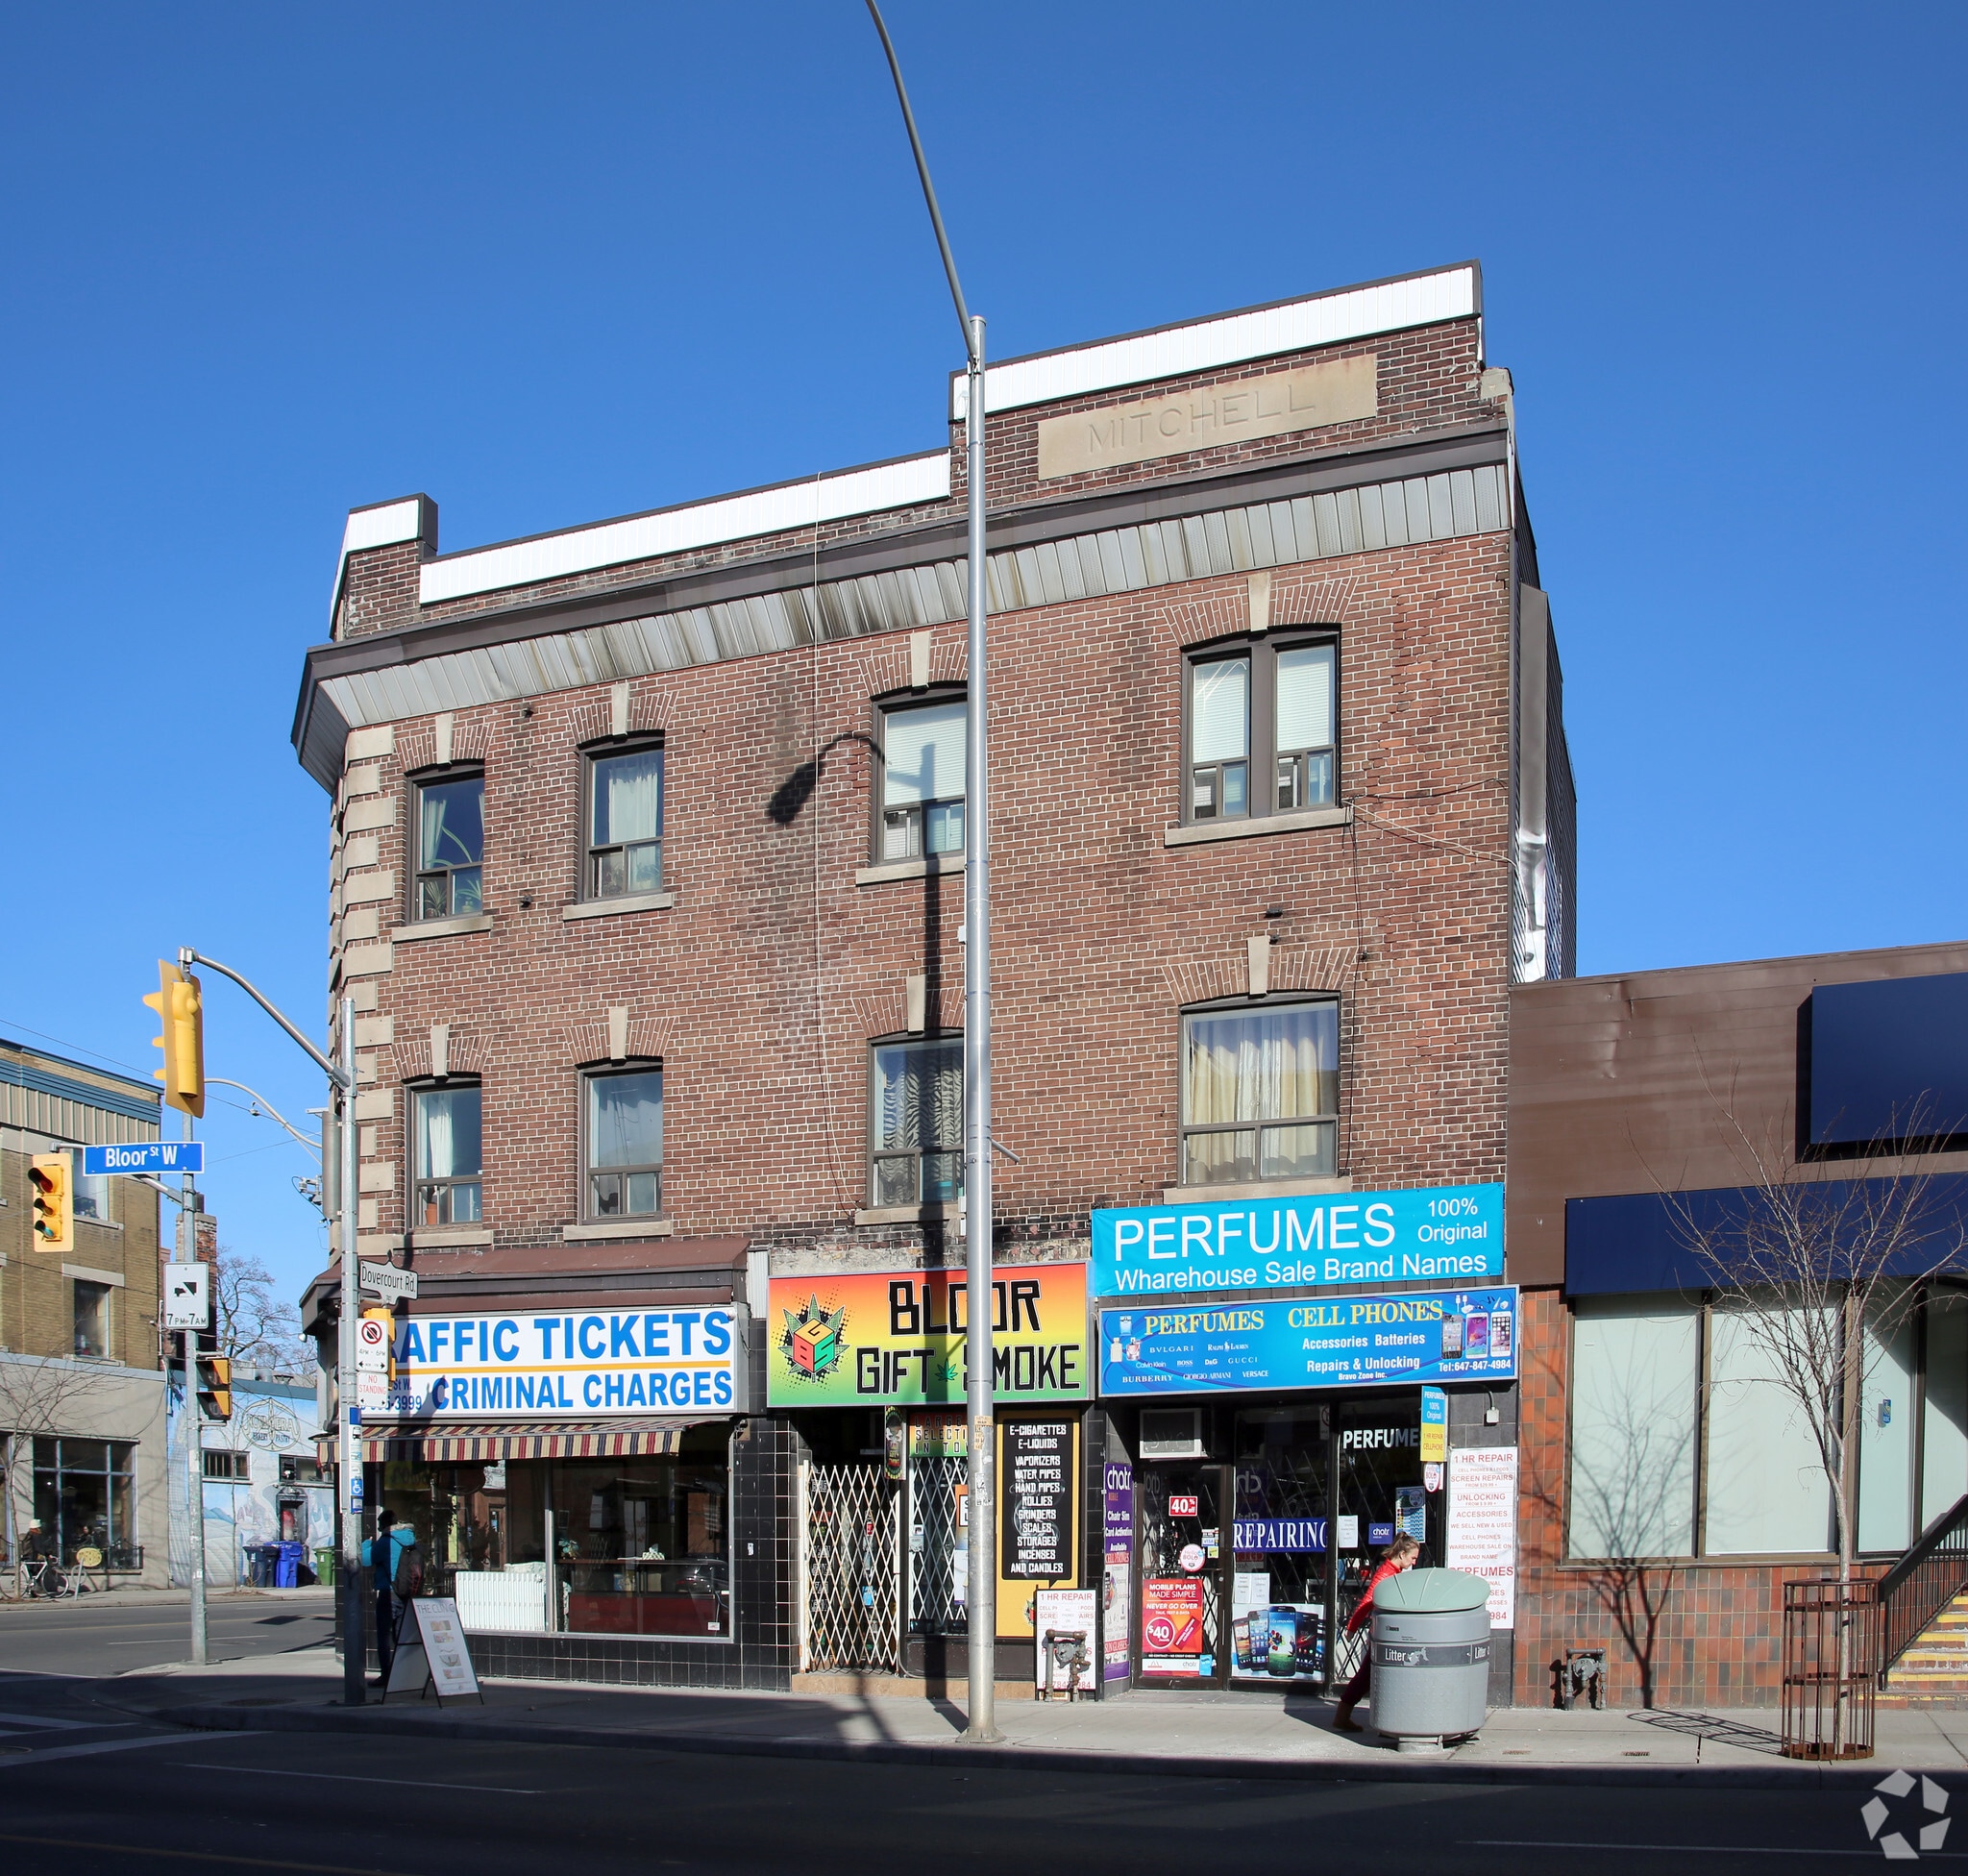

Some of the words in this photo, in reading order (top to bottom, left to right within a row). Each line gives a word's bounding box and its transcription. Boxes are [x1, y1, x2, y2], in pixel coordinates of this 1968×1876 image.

[1087, 383, 1316, 455] MITCHELL
[105, 1147, 148, 1168] Bloor
[150, 1146, 160, 1157] St
[161, 1146, 178, 1165] W
[1427, 1197, 1479, 1218] 100%
[1114, 1202, 1395, 1262] PERFUMES
[1417, 1221, 1488, 1246] Original
[1115, 1265, 1257, 1292] Wharehouse
[1265, 1258, 1316, 1284] Sale
[1324, 1256, 1394, 1281] Brand
[1402, 1253, 1487, 1275] Names
[361, 1266, 404, 1290] Dovercourt
[406, 1275, 416, 1293] Rd.
[888, 1279, 1041, 1336] BLOOR
[1144, 1310, 1265, 1336] PERFUMES
[1288, 1305, 1345, 1328] CELL
[1350, 1299, 1443, 1325] PHONES
[391, 1320, 519, 1363] AFFIC
[534, 1311, 731, 1360] TICKETS
[1302, 1335, 1368, 1350] Accessories
[1375, 1333, 1426, 1346] Batteries
[856, 1345, 936, 1395] GIFT
[963, 1344, 1081, 1393] MOKE
[1307, 1359, 1349, 1374] Repairs
[1353, 1358, 1362, 1370] &
[1365, 1356, 1420, 1372] Unlocking
[368, 1374, 378, 1384] NO
[1122, 1374, 1173, 1383] BURBERRY
[1338, 1372, 1357, 1381] Bravo
[358, 1385, 386, 1395] STANDING
[432, 1374, 573, 1410] CRIMINAL
[583, 1370, 732, 1408] CHARGES
[915, 1416, 962, 1427] LARGE
[915, 1428, 967, 1441] SELECTI
[1009, 1424, 1067, 1436] E-CIGARETTES
[915, 1442, 929, 1454] IN
[943, 1442, 969, 1453] TO
[1019, 1438, 1058, 1449] E-LIQUIDS
[1015, 1455, 1061, 1467] VAPORIZERS
[1478, 1453, 1513, 1463] REPAIR
[1015, 1469, 1037, 1480] WATER
[1039, 1469, 1061, 1480] PIPES
[1015, 1482, 1036, 1493] HAND
[1038, 1482, 1061, 1493] PIPES
[1021, 1495, 1053, 1506] ROLLIES
[1019, 1509, 1057, 1519] GRINDERS
[1022, 1522, 1052, 1533] SCALES
[1017, 1536, 1057, 1546] STORAGES
[1019, 1549, 1056, 1560] INCENSES
[1011, 1563, 1026, 1573] AND
[1028, 1563, 1064, 1573] CANDLES
[1148, 1625, 1169, 1639] $40
[1385, 1648, 1407, 1662] Litter
